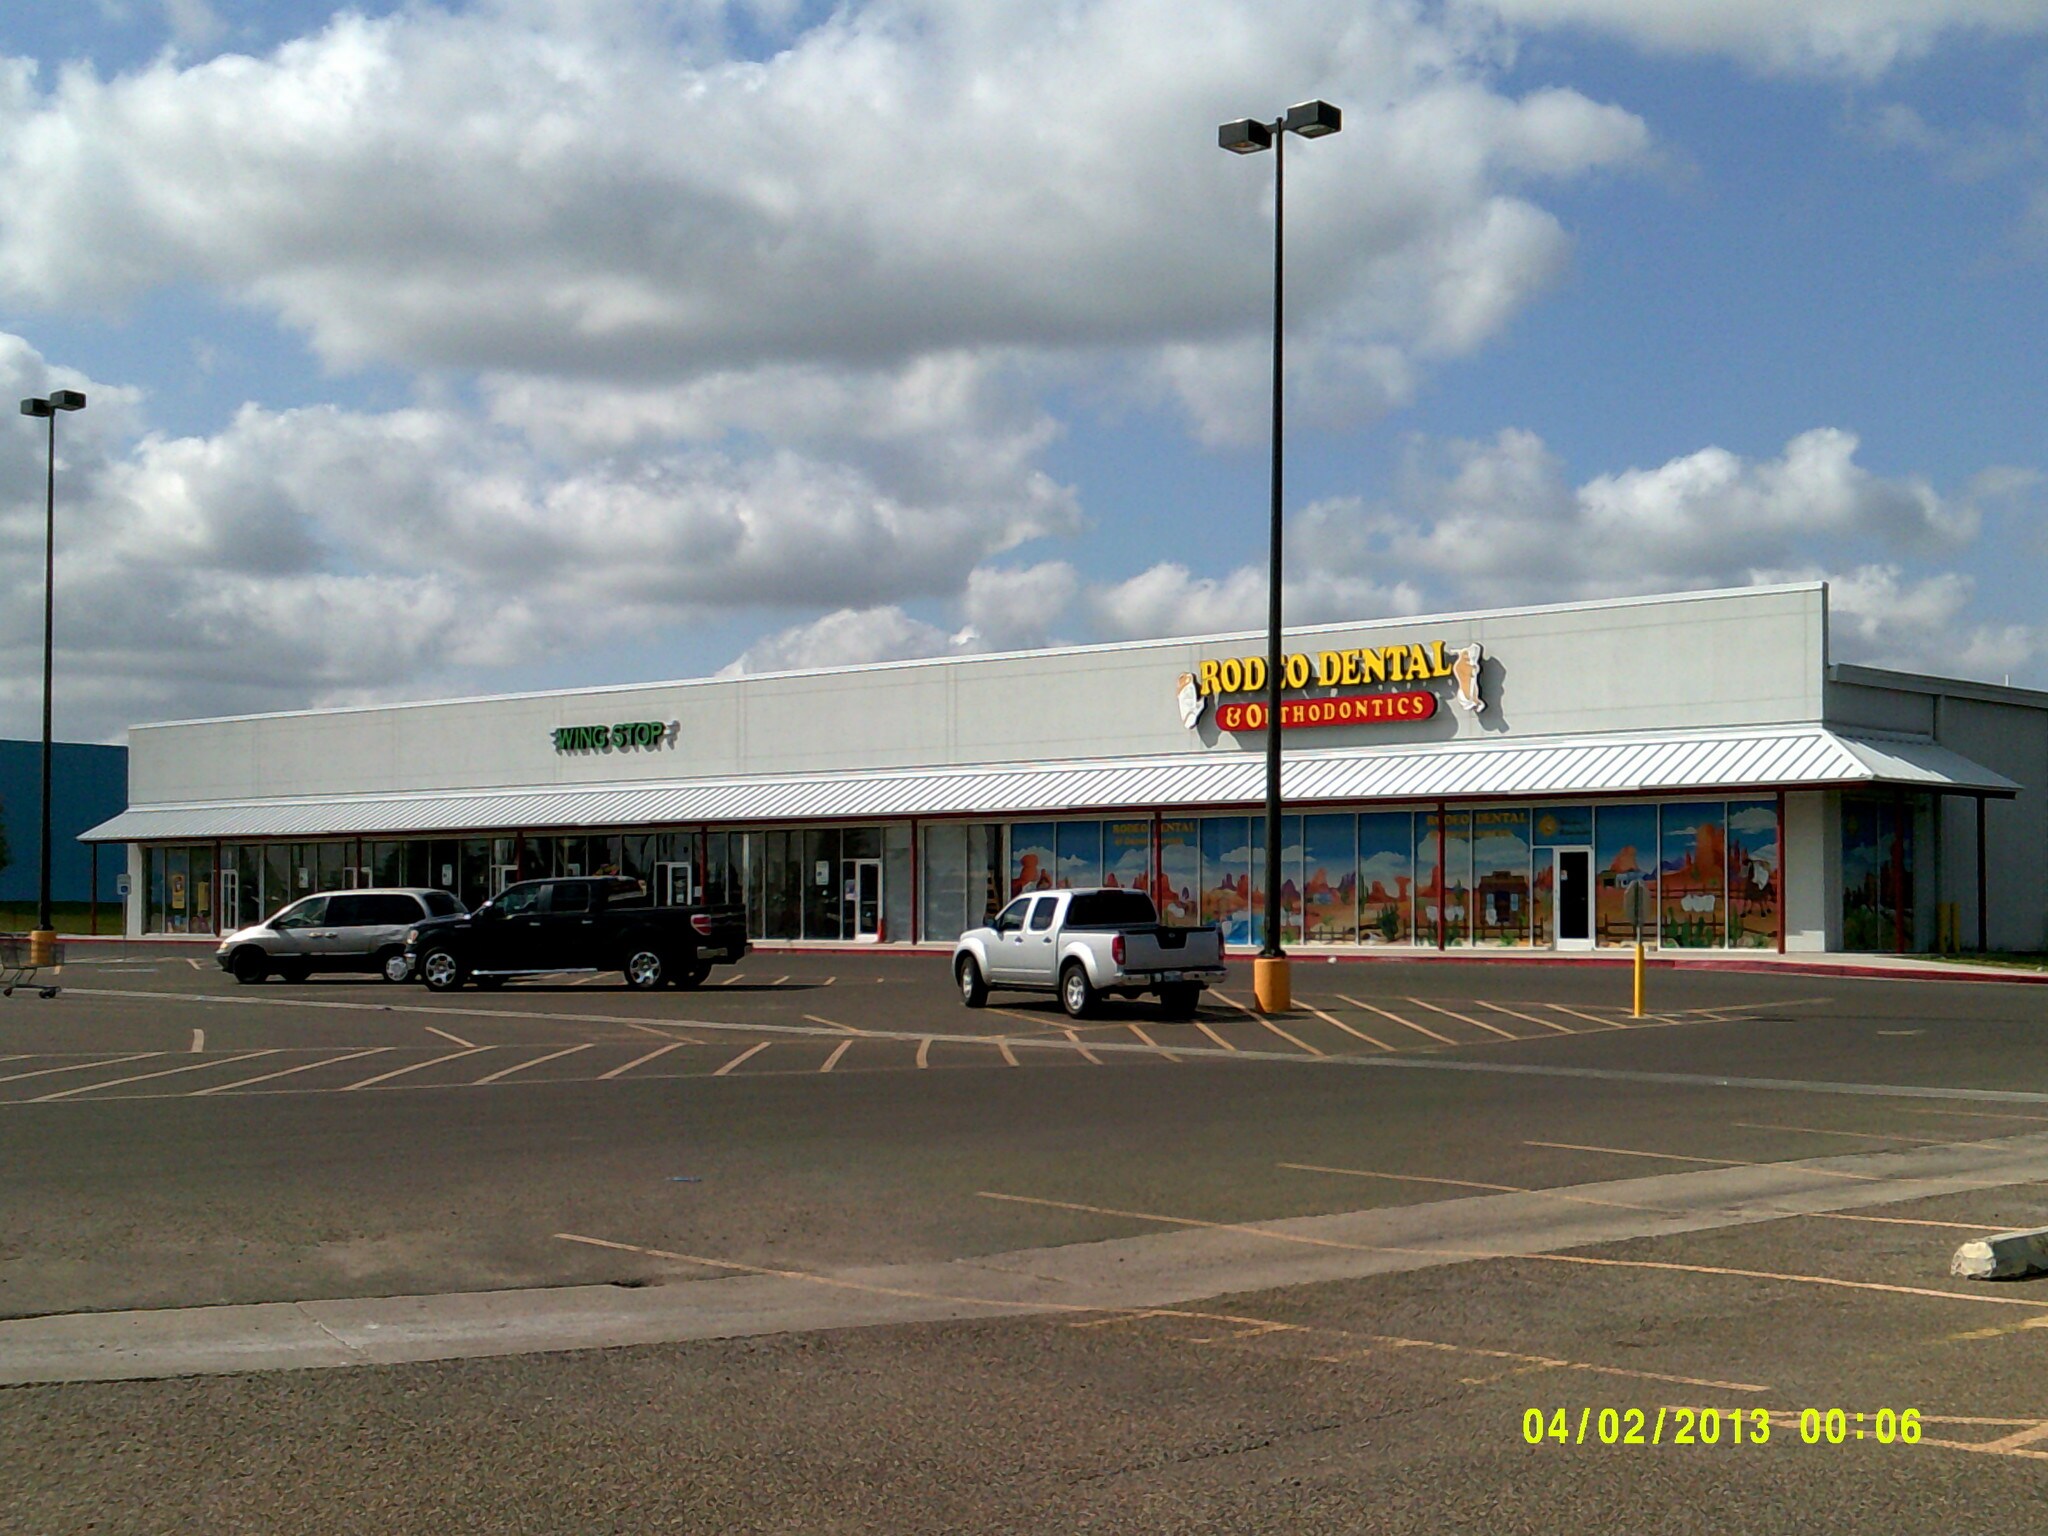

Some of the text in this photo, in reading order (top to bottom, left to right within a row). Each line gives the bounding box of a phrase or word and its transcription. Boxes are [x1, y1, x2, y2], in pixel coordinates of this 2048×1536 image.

[1317, 640, 1453, 687] DENTAL
[1246, 695, 1425, 728] OTHODONTICS
[556, 721, 666, 750] WING STOP
[1159, 822, 1195, 833] ENTAL
[1427, 814, 1470, 825] RDEO
